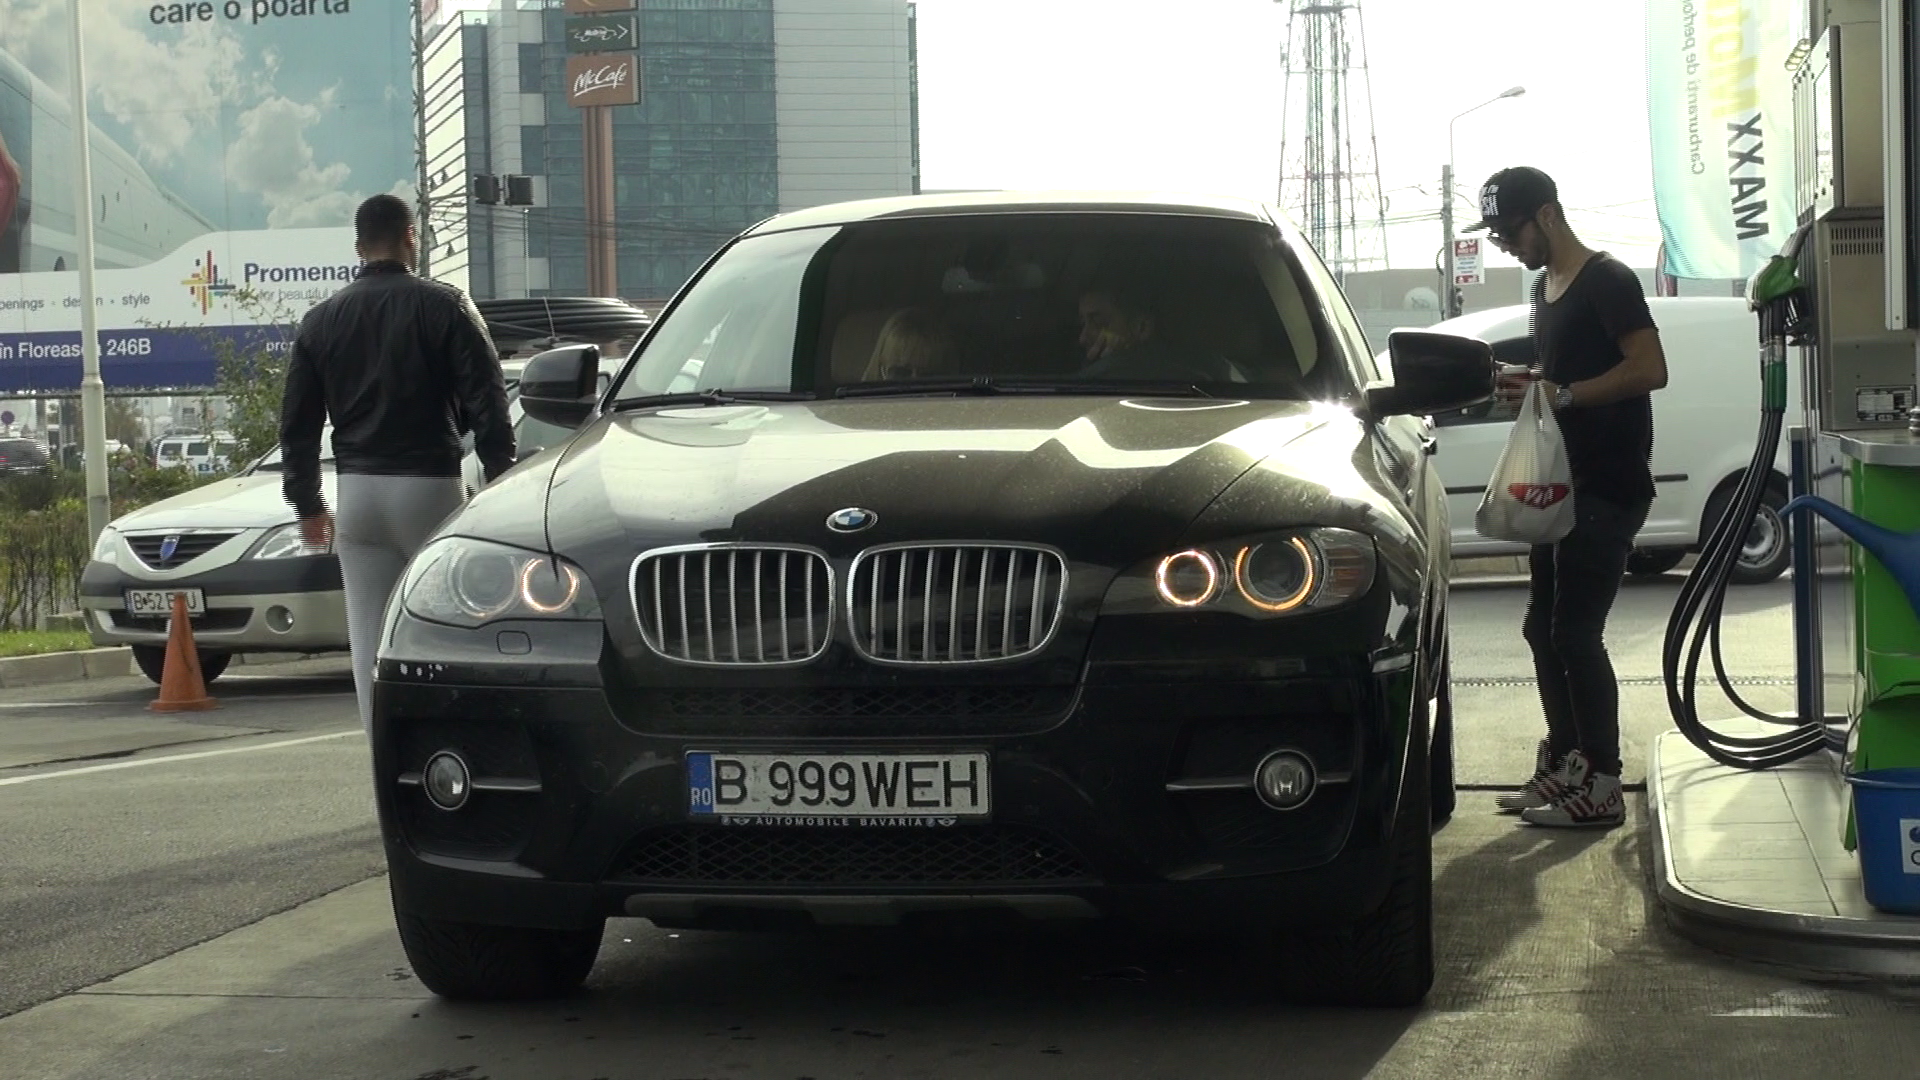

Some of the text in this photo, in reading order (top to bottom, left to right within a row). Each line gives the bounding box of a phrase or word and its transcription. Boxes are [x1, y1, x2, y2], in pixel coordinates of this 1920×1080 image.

[149, 1, 213, 24] care
[223, 0, 241, 20] o
[121, 292, 151, 309] style
[106, 338, 152, 356] 246B
[714, 760, 748, 805] B
[690, 788, 711, 806] RO
[755, 816, 923, 827] AUTOMOBILE BAVARIA
